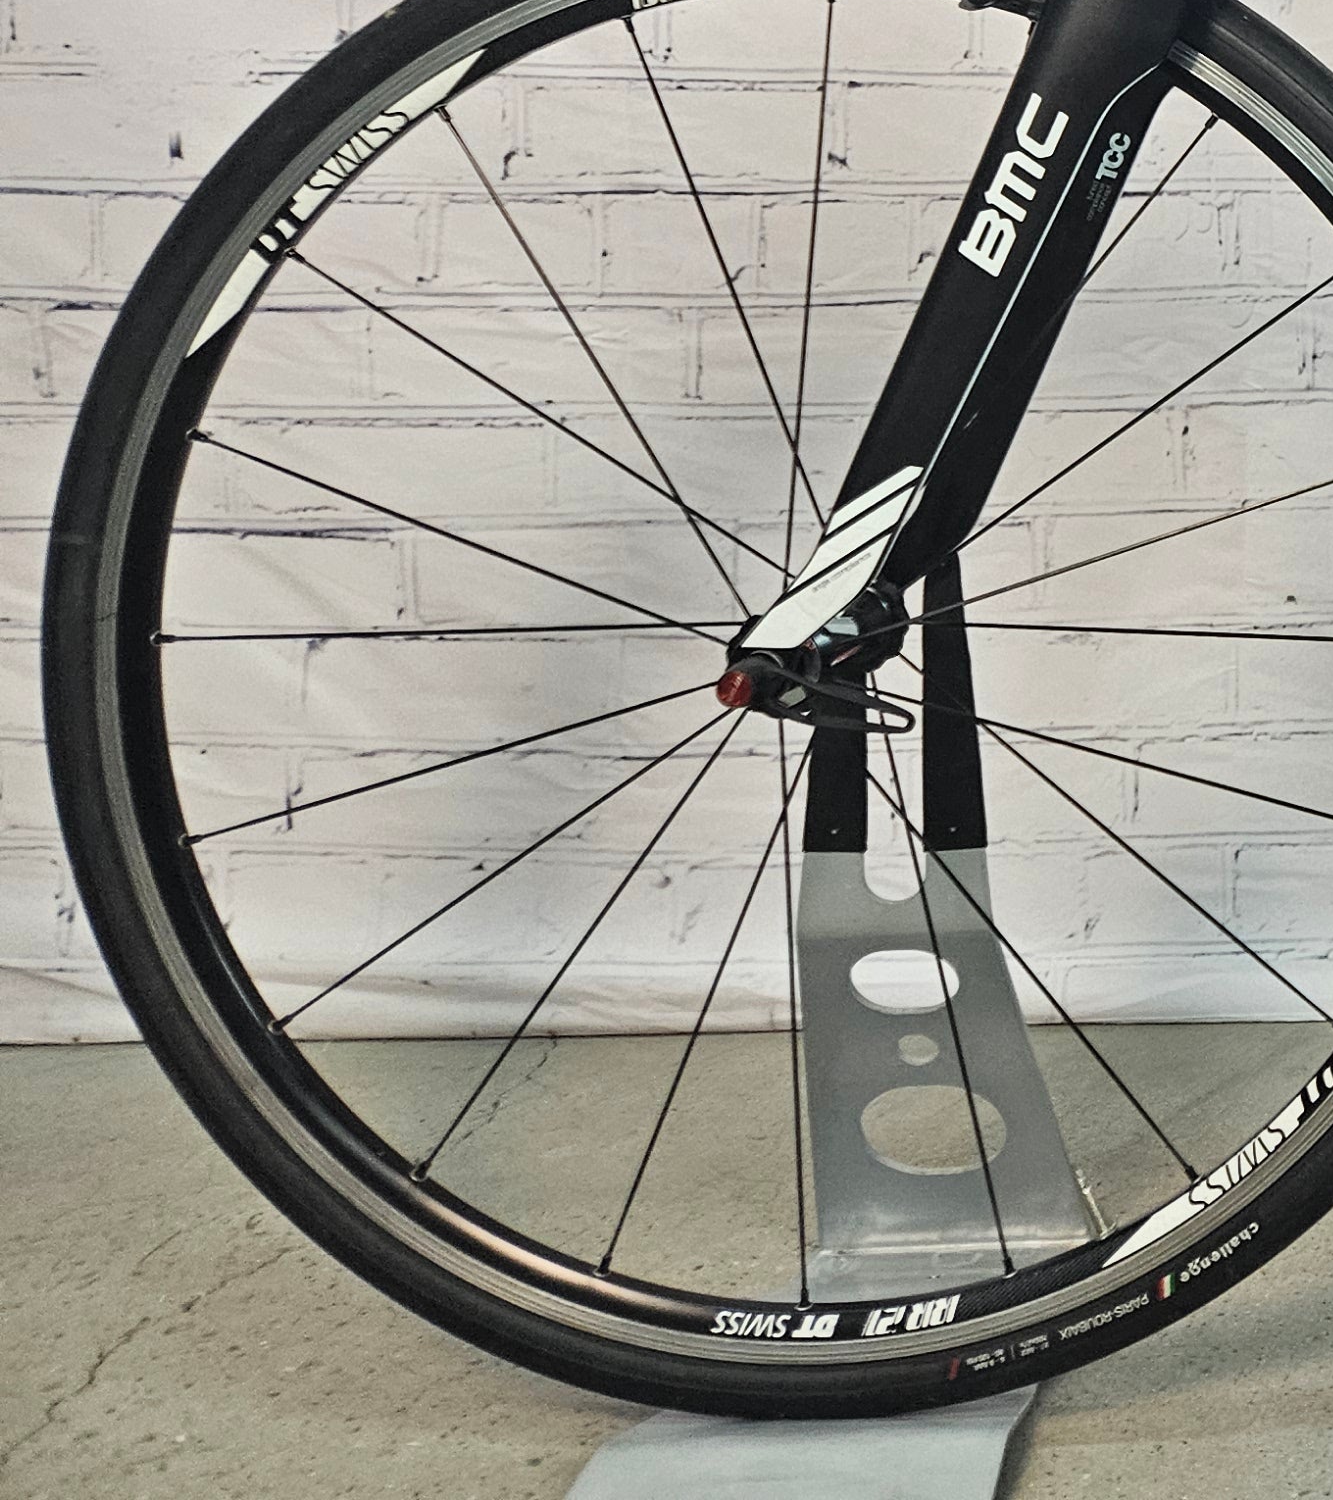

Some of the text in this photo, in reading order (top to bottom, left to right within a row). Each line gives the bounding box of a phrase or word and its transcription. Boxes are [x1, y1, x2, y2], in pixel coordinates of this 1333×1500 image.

[1095, 132, 1131, 180] TCC
[958, 93, 1069, 278] BMC
[1180, 1221, 1260, 1283] challenge
[710, 1310, 840, 1339] DT SWISS
[1059, 1292, 1150, 1340] PARIS-ROUBAIX
